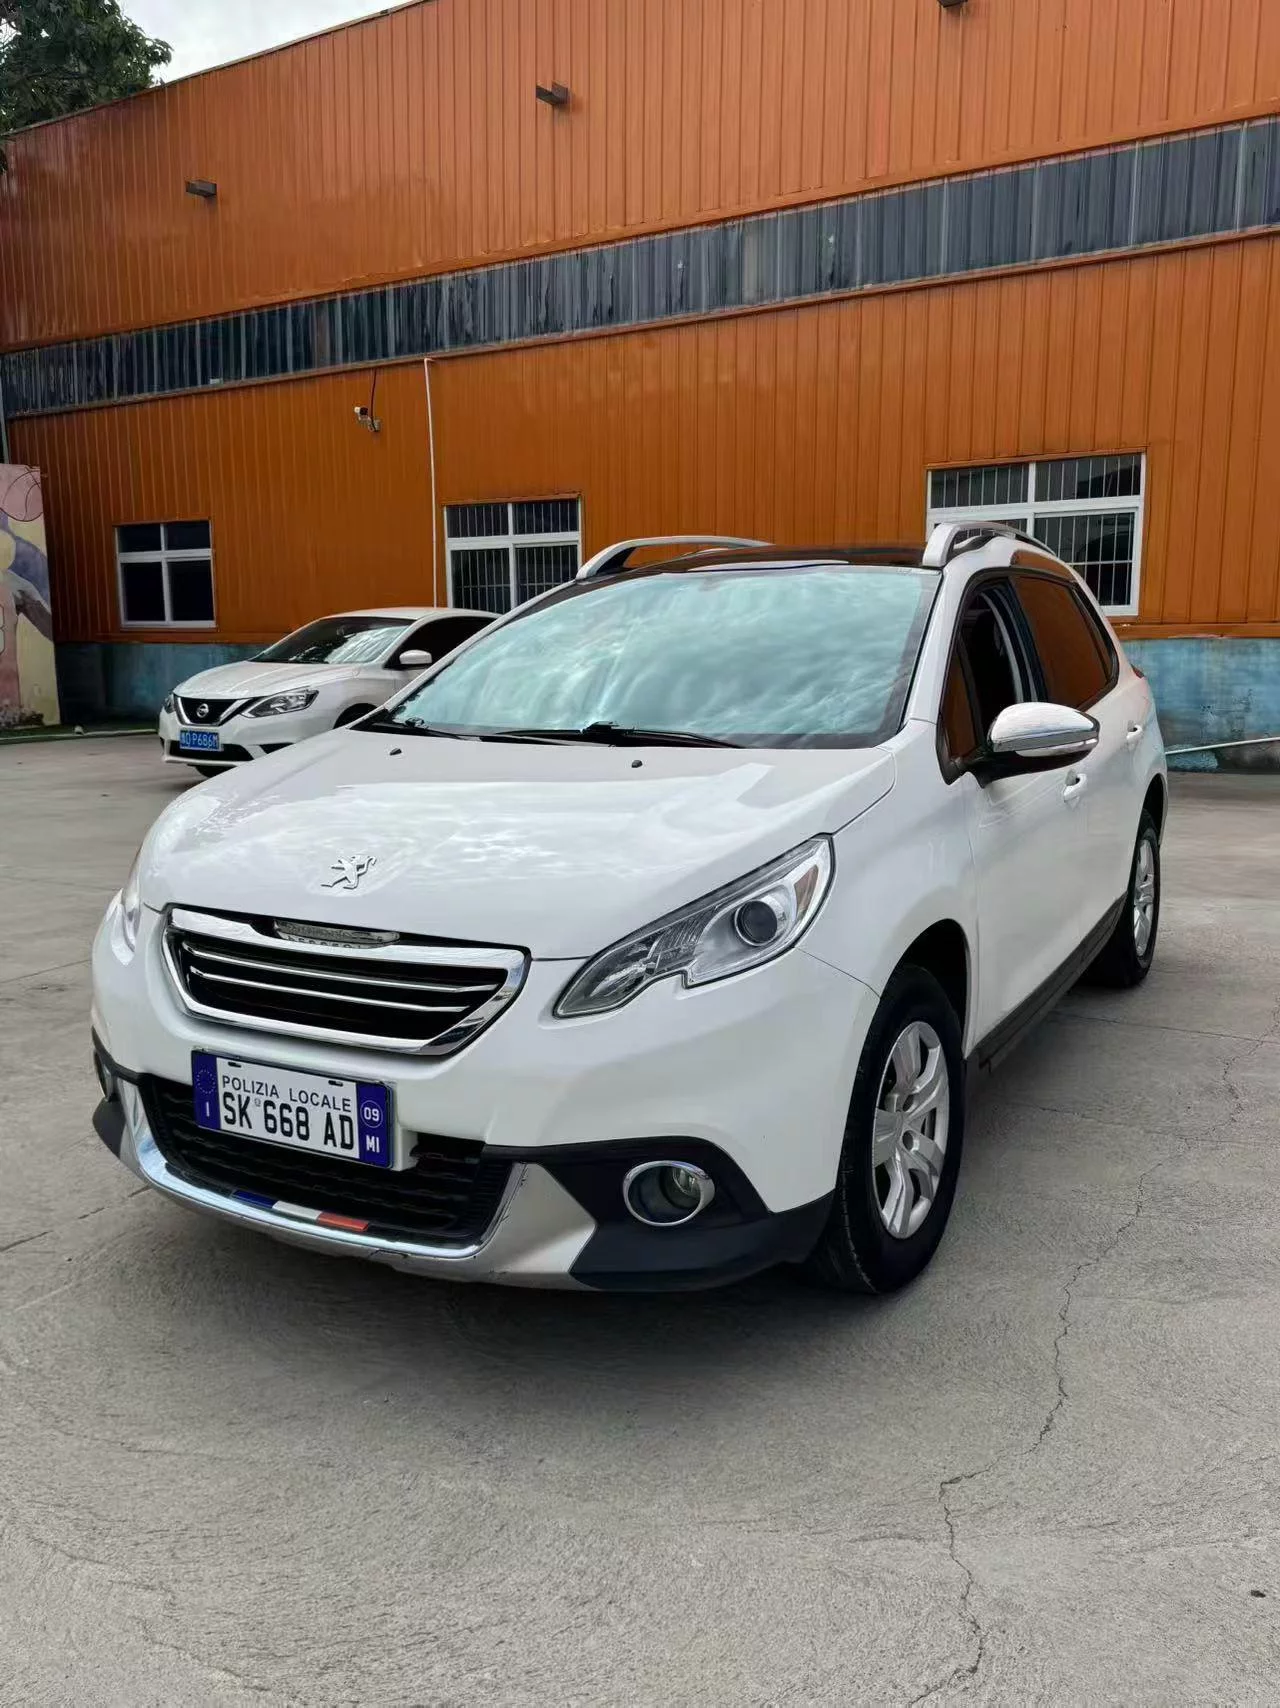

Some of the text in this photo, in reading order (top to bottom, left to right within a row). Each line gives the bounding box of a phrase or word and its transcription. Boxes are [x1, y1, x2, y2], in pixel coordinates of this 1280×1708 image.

[222, 1075, 352, 1113] POLIZIA LOCALE
[205, 1101, 211, 1118] I
[363, 1106, 380, 1122] 09
[222, 1092, 354, 1150] SK 668 AD
[366, 1135, 380, 1153] MI
